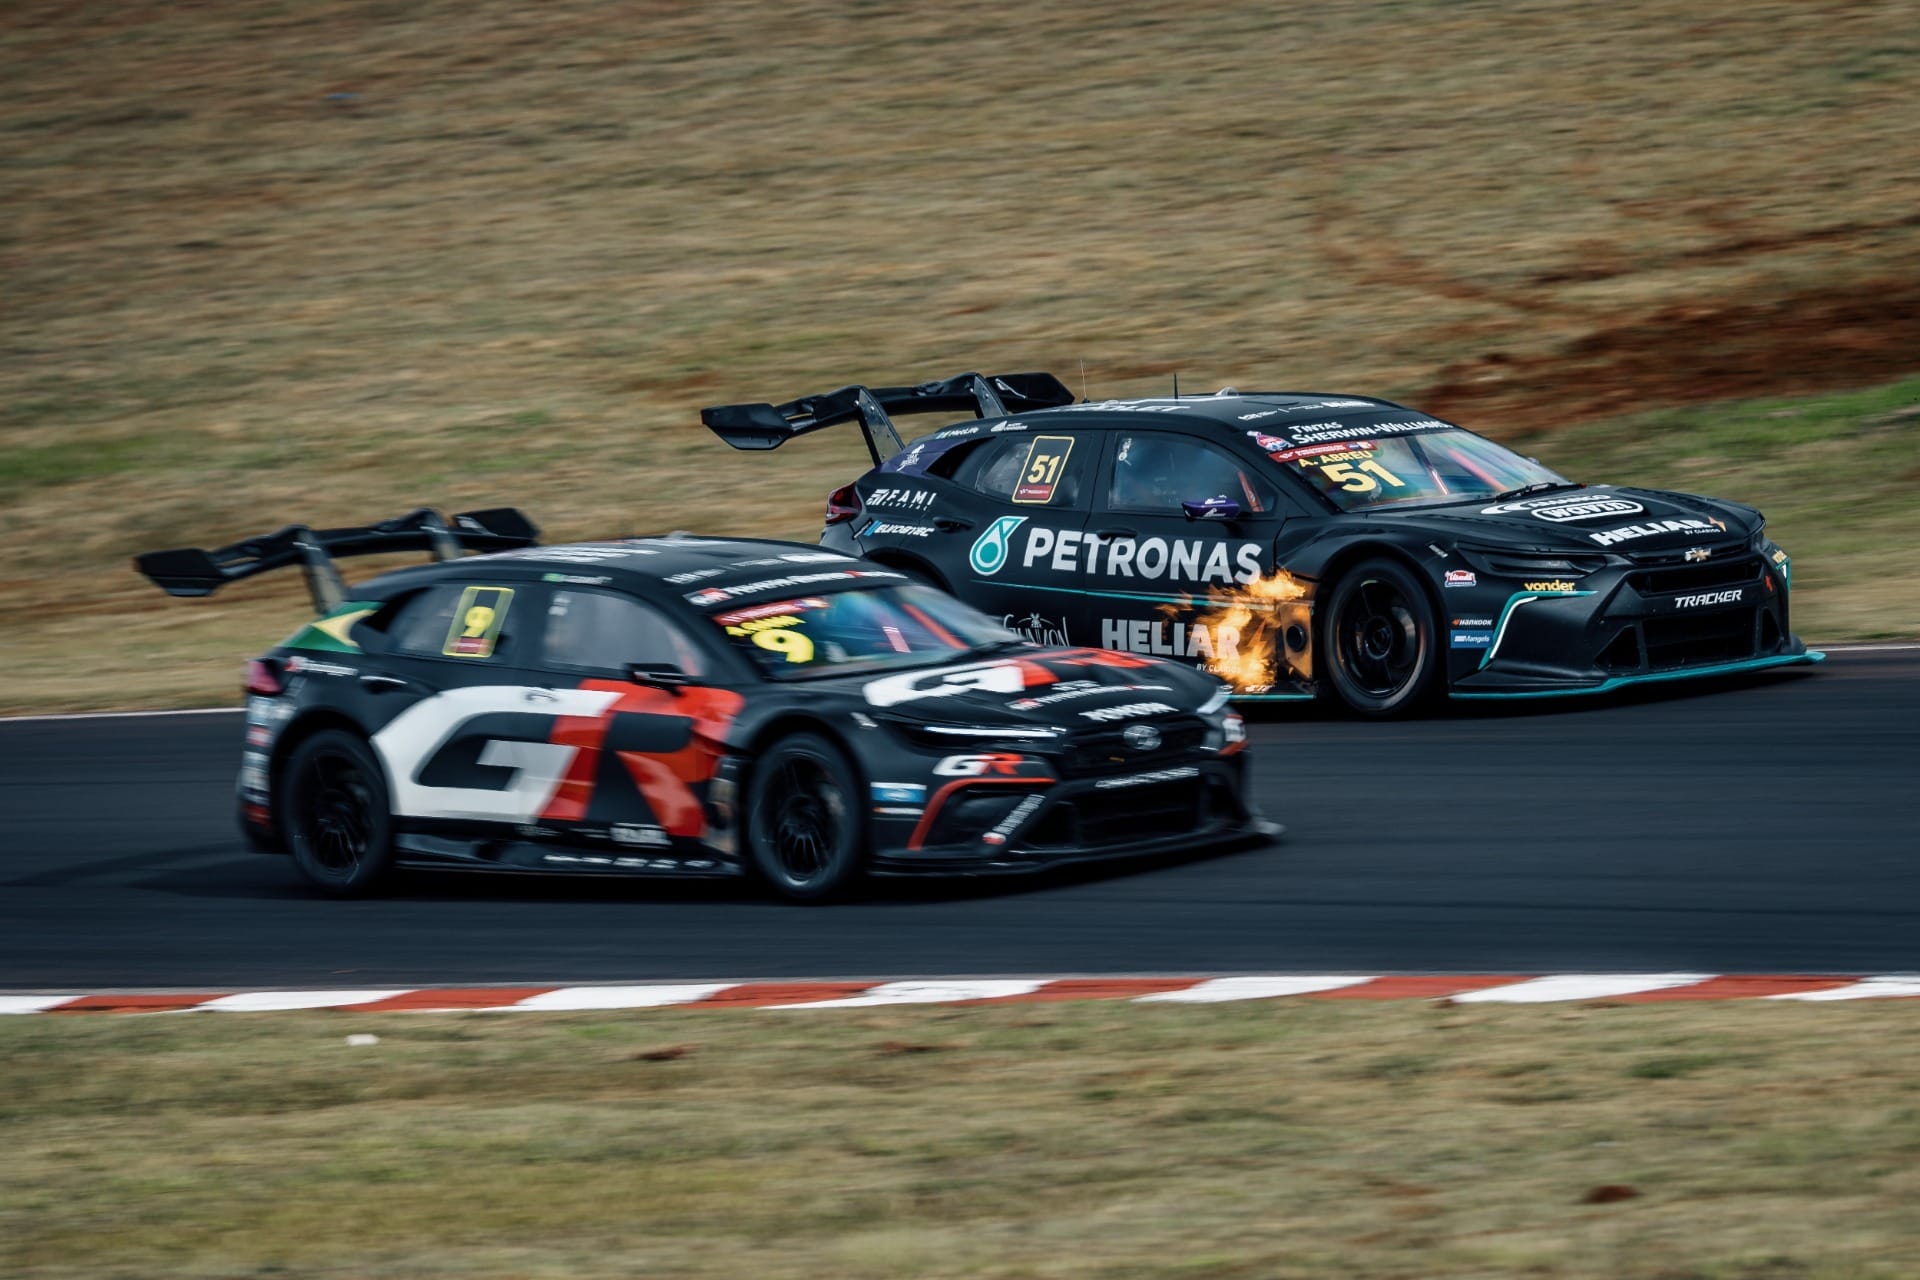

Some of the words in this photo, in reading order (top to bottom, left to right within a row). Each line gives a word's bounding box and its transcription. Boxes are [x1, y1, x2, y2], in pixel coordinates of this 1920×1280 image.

[1288, 421, 1343, 434] TINTAS
[1292, 420, 1453, 444] SHERWIN-WILLIAMS
[1027, 454, 1061, 484] 51
[1320, 450, 1374, 464] ABREU
[1320, 459, 1406, 493] 51
[886, 489, 937, 506] FAMI
[1589, 519, 1715, 547] HELIAR
[1022, 527, 1263, 586] PETRONAS
[1524, 578, 1576, 592] vonder
[1674, 589, 1743, 609] TRACKER
[751, 629, 815, 664] 9
[1101, 618, 1242, 660] HELIAR
[369, 678, 746, 838] GR
[932, 752, 1025, 776] GR
